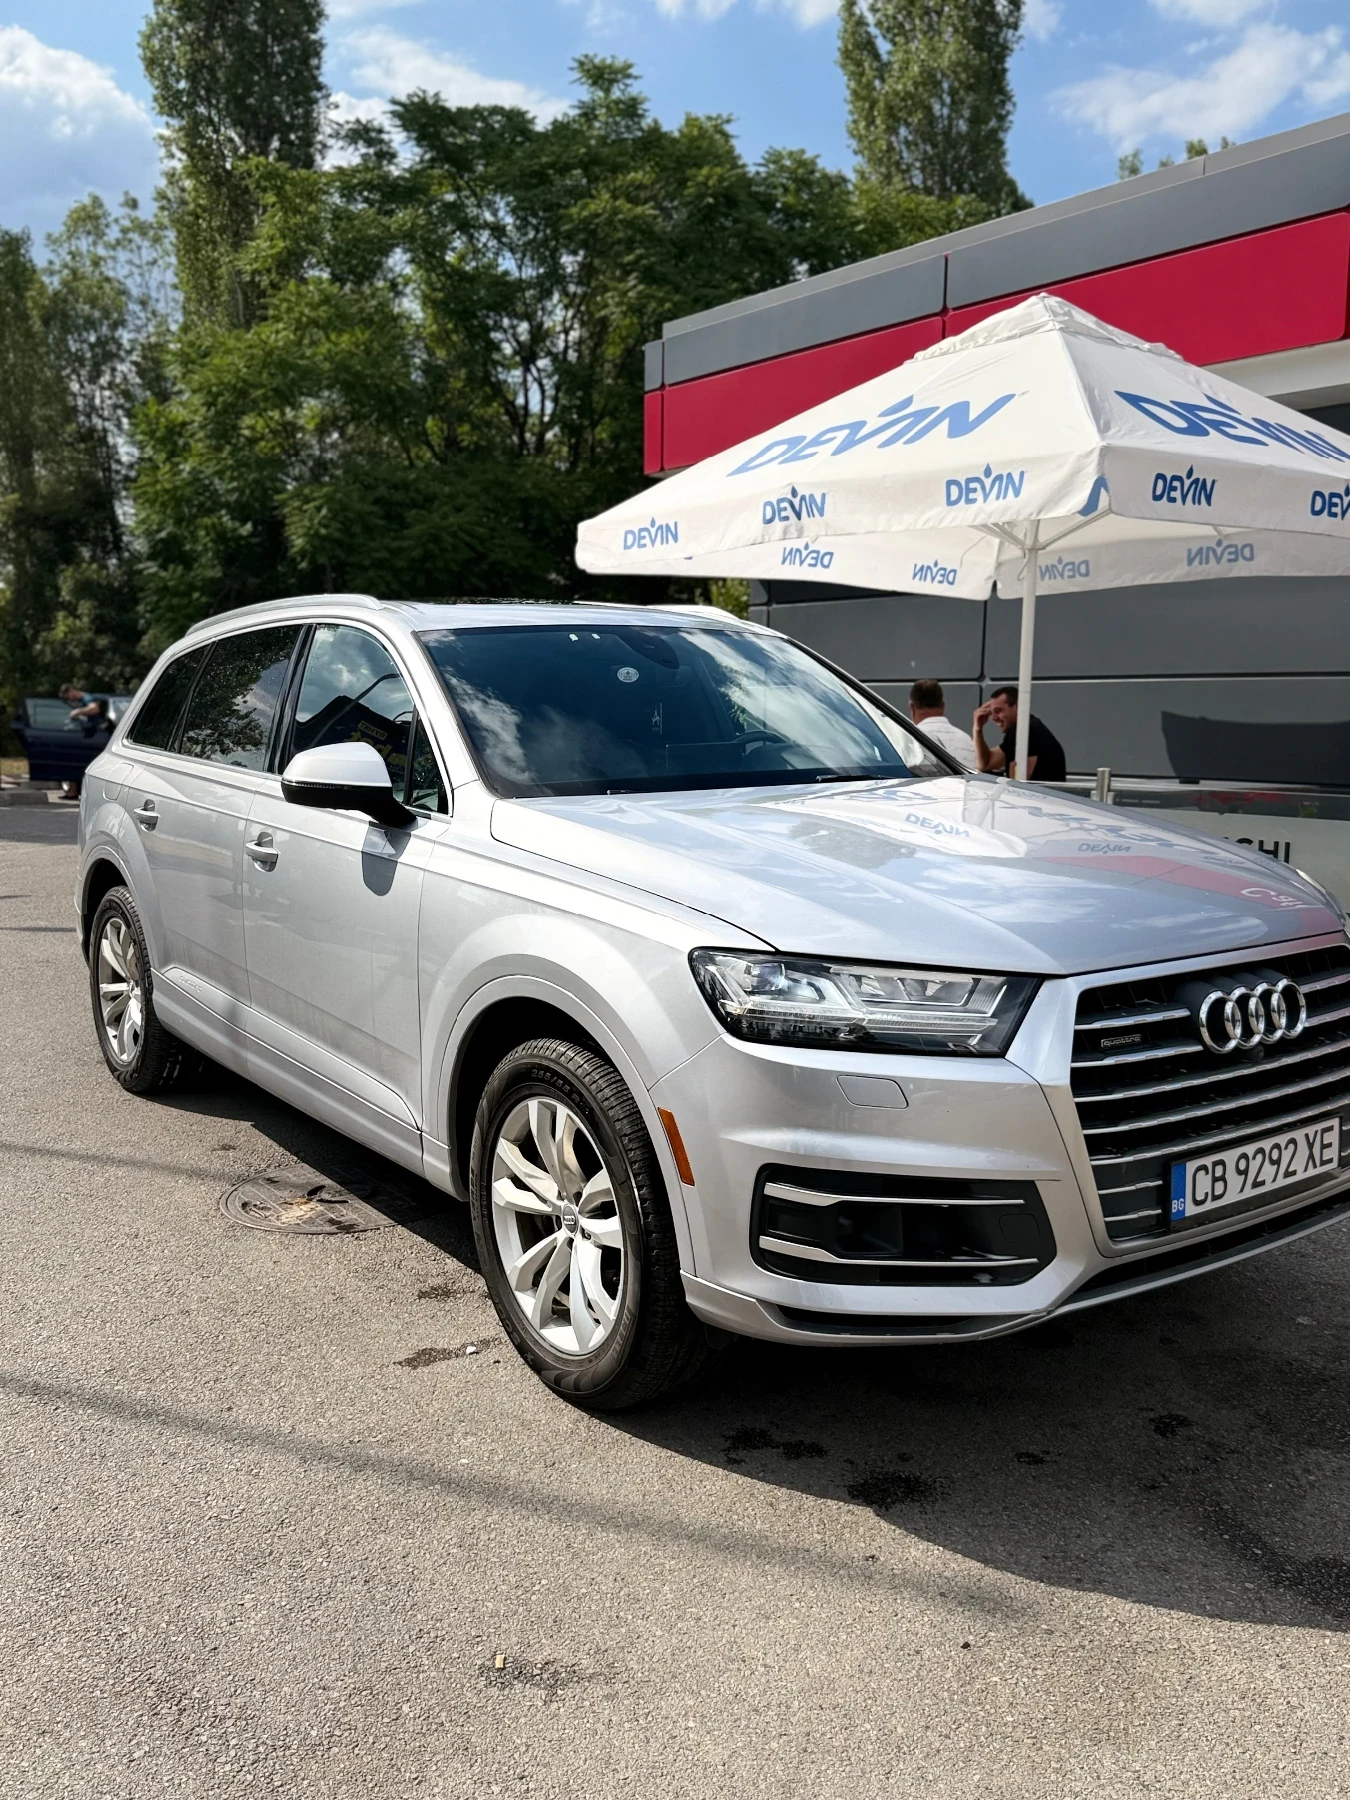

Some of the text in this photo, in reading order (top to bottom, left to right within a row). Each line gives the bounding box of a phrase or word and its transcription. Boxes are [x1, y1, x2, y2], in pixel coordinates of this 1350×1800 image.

[725, 393, 1017, 478] DEVIN
[1113, 389, 1350, 463] DEVIN
[762, 485, 826, 525] DEVIN
[945, 463, 1025, 507] DEVIN
[1151, 464, 1217, 507] DEVIN
[623, 516, 679, 551] DEVIN
[1103, 1035, 1141, 1048] quattro
[1191, 1124, 1334, 1206] CB 9292 XE
[1171, 1197, 1185, 1213] BG
